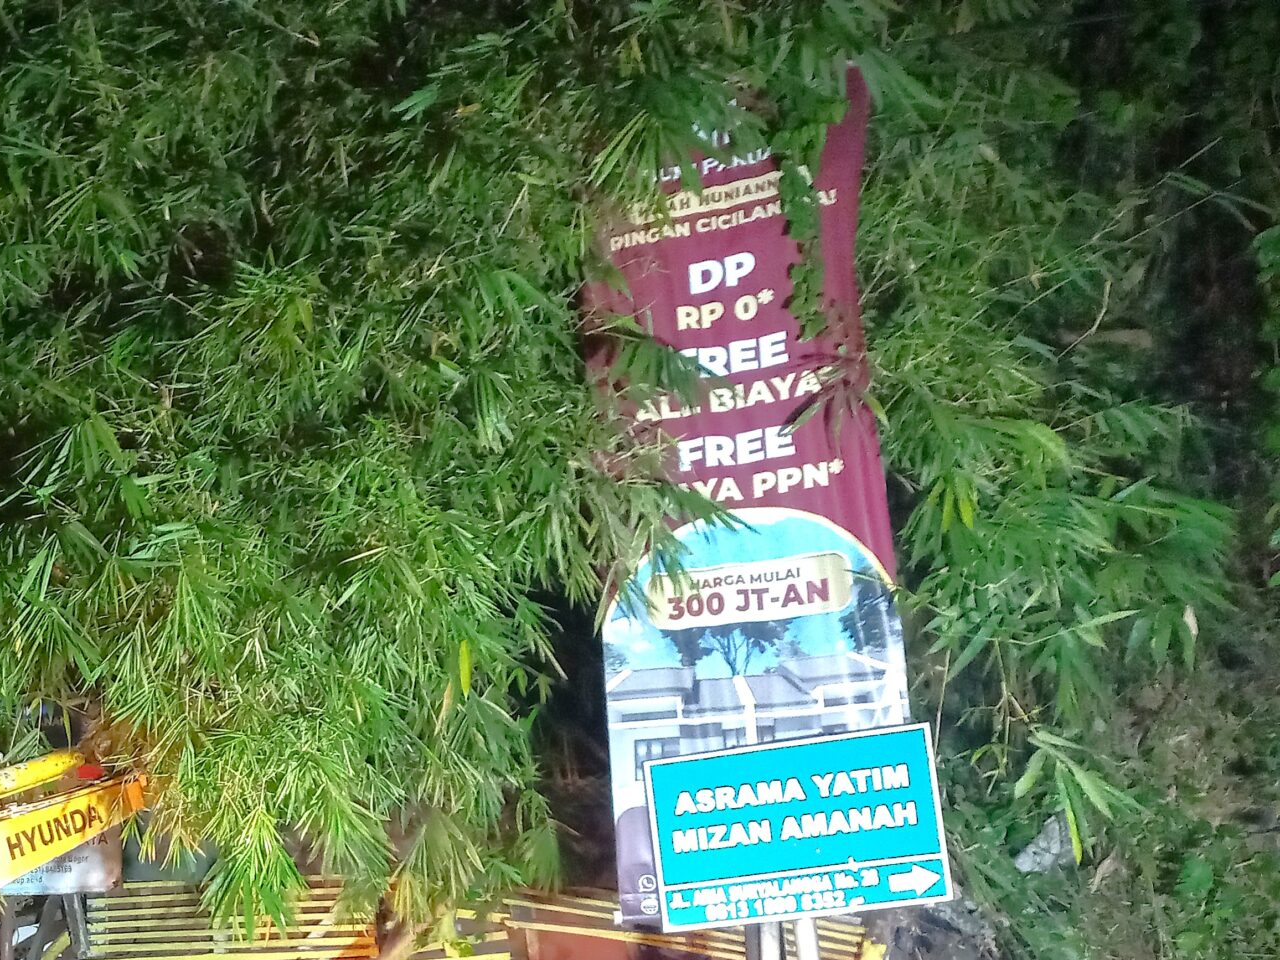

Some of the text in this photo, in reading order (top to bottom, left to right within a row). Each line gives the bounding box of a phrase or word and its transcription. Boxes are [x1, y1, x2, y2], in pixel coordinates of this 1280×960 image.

[687, 251, 756, 295] DP
[676, 301, 725, 331] RP
[678, 330, 789, 377] REE
[677, 425, 796, 472] FREE
[667, 577, 830, 621] 300 JT-AN
[690, 567, 801, 591] HARGA MULAI
[673, 762, 911, 817] ASRAMA YATIM
[6, 803, 104, 861] HYUNDA
[671, 800, 919, 854] MIZAN AMANAH
